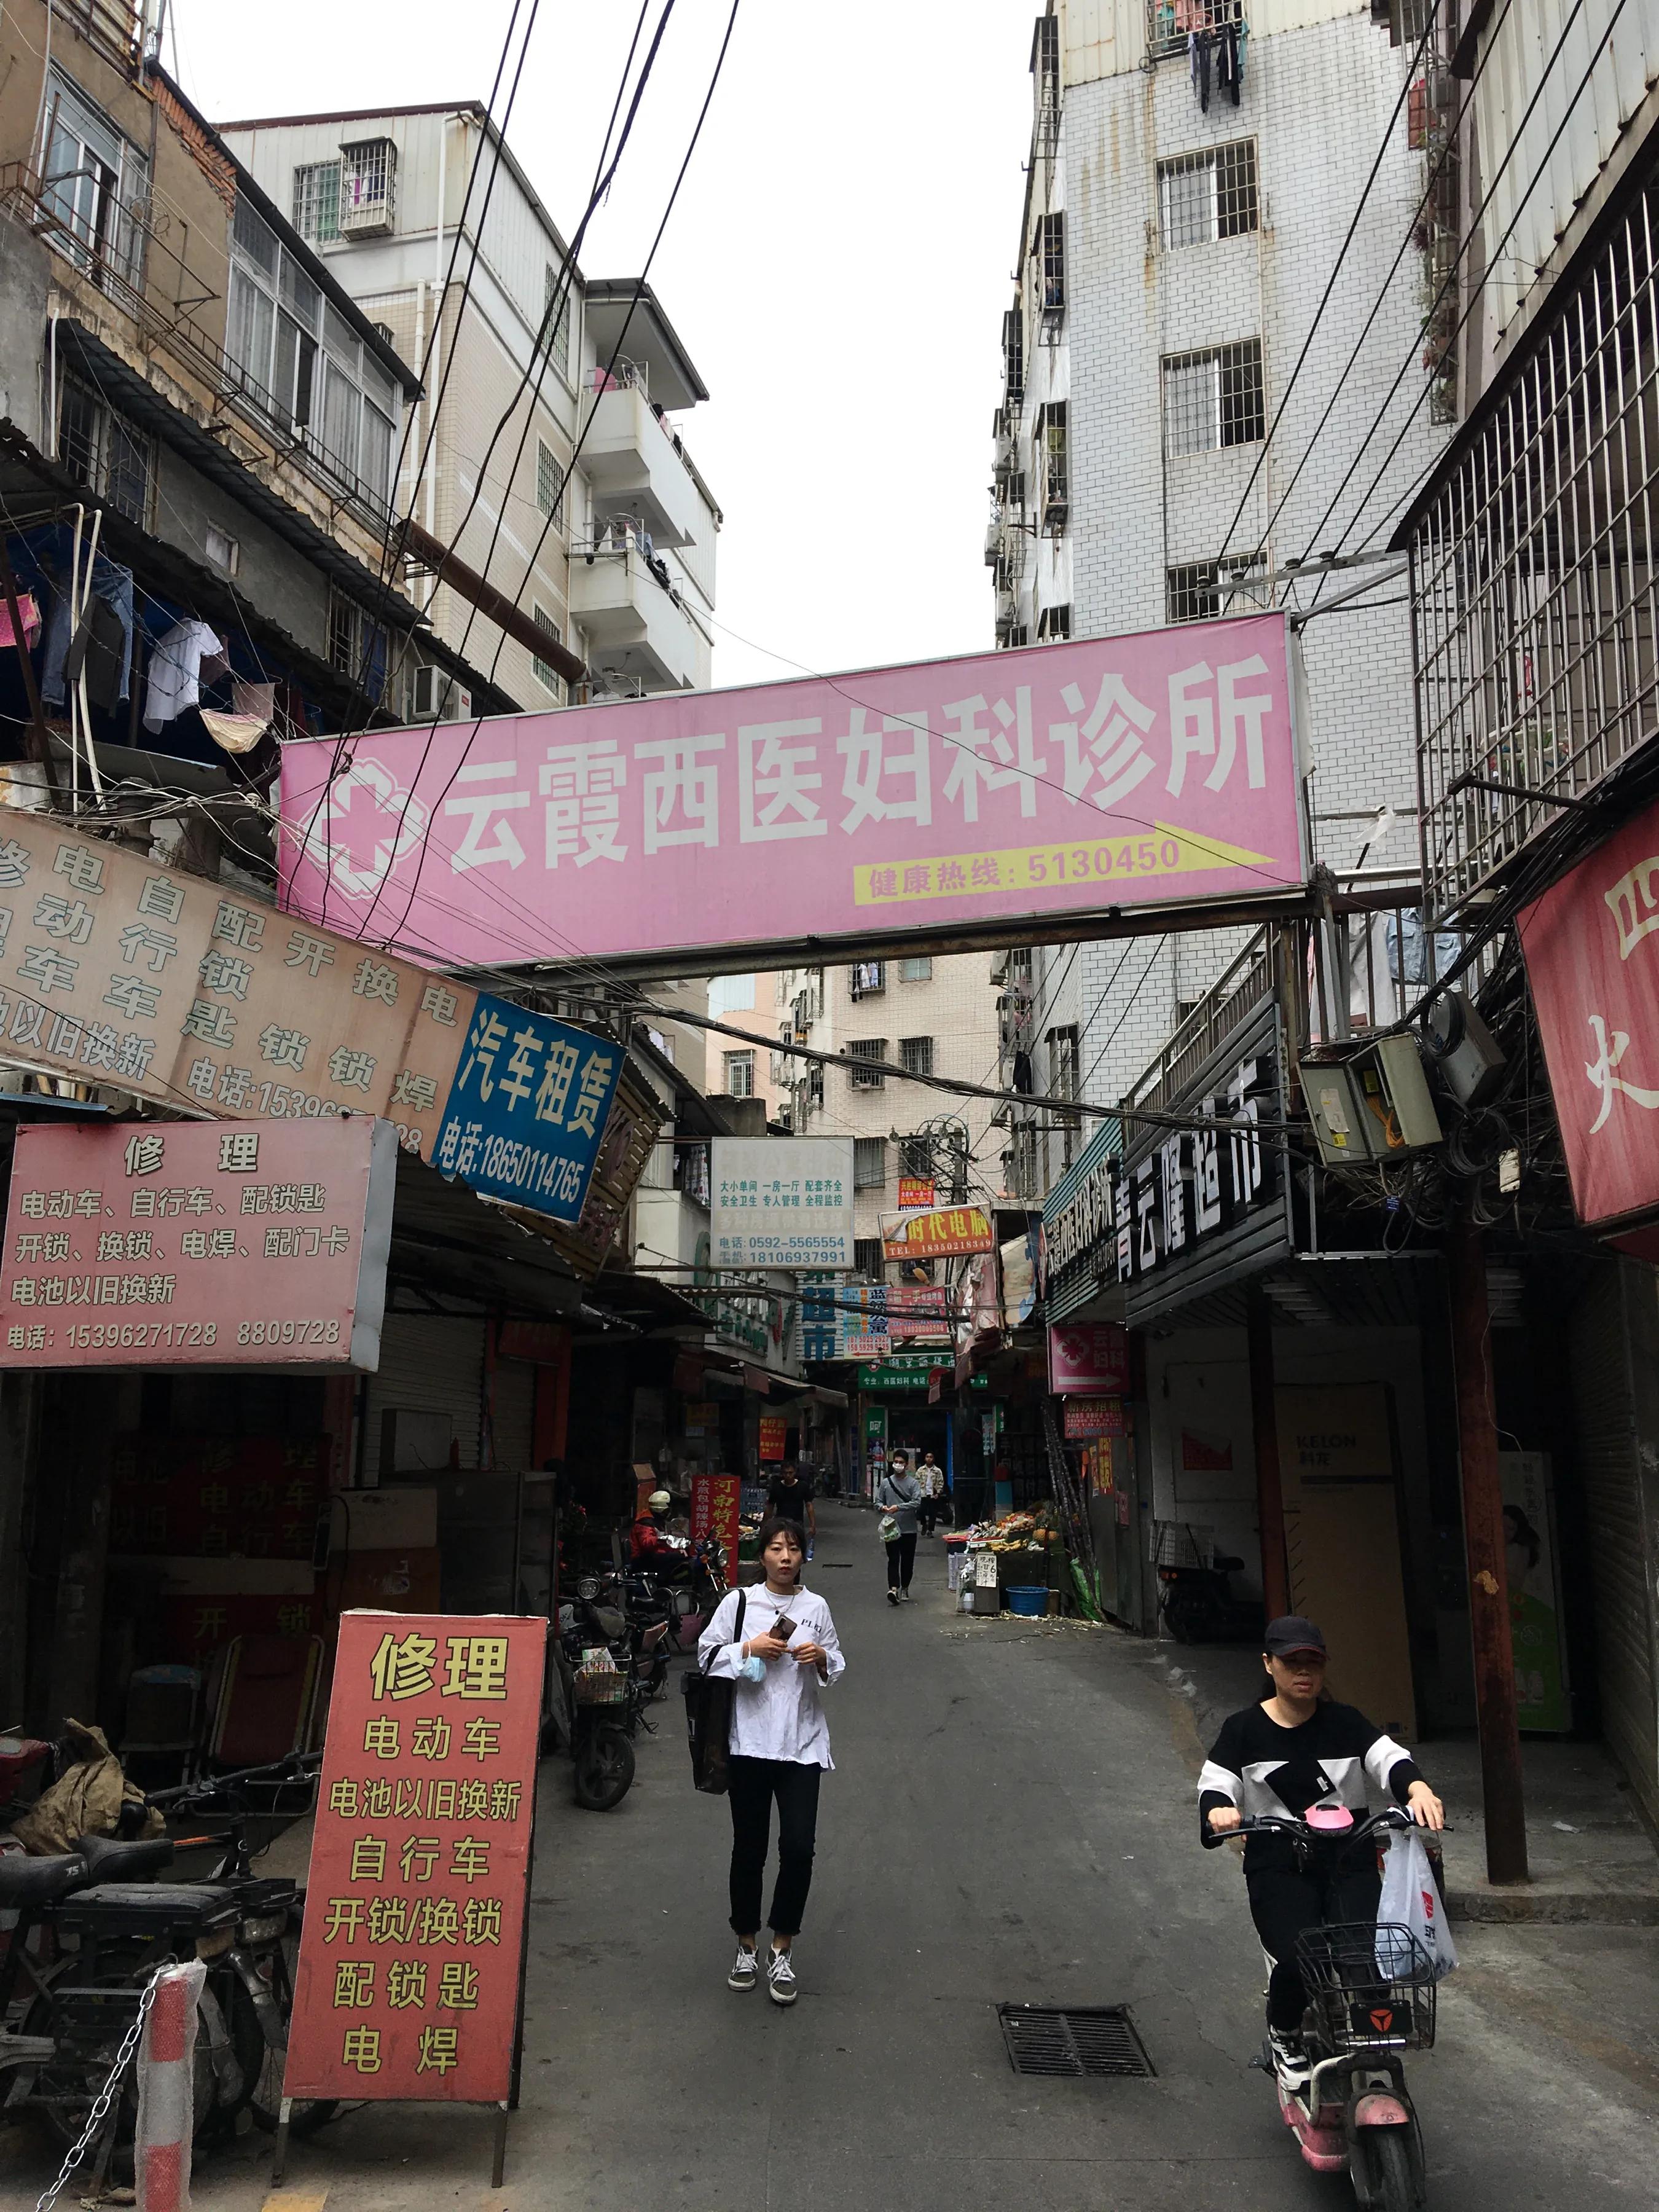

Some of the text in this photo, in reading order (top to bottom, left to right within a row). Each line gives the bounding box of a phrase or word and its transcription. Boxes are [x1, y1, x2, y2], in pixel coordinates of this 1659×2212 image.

[446, 651, 1273, 873] 云霞西医妇科诊所
[0, 992, 156, 1080] 以旧换新
[458, 1009, 612, 1139] 汽车租赁
[125, 1133, 259, 1175] 修理
[720, 1180, 842, 1192] 大小单间 一房一厅 配套齐全
[720, 1194, 842, 1207] 安全卫生 专人管理 全程监控
[922, 1240, 991, 1253] 18350218349
[11, 1274, 176, 1306] 电池以旧换新
[237, 1319, 340, 1345] 8809728
[371, 1633, 509, 1701] 修理
[363, 1716, 501, 1762] 电动车
[329, 1778, 521, 1821] 电池以旧换新
[349, 1835, 491, 1883] 自行车
[324, 1897, 503, 1947] 开锁/换锁
[333, 1960, 479, 2010] 配锁匙
[342, 2025, 458, 2076] 电焊
